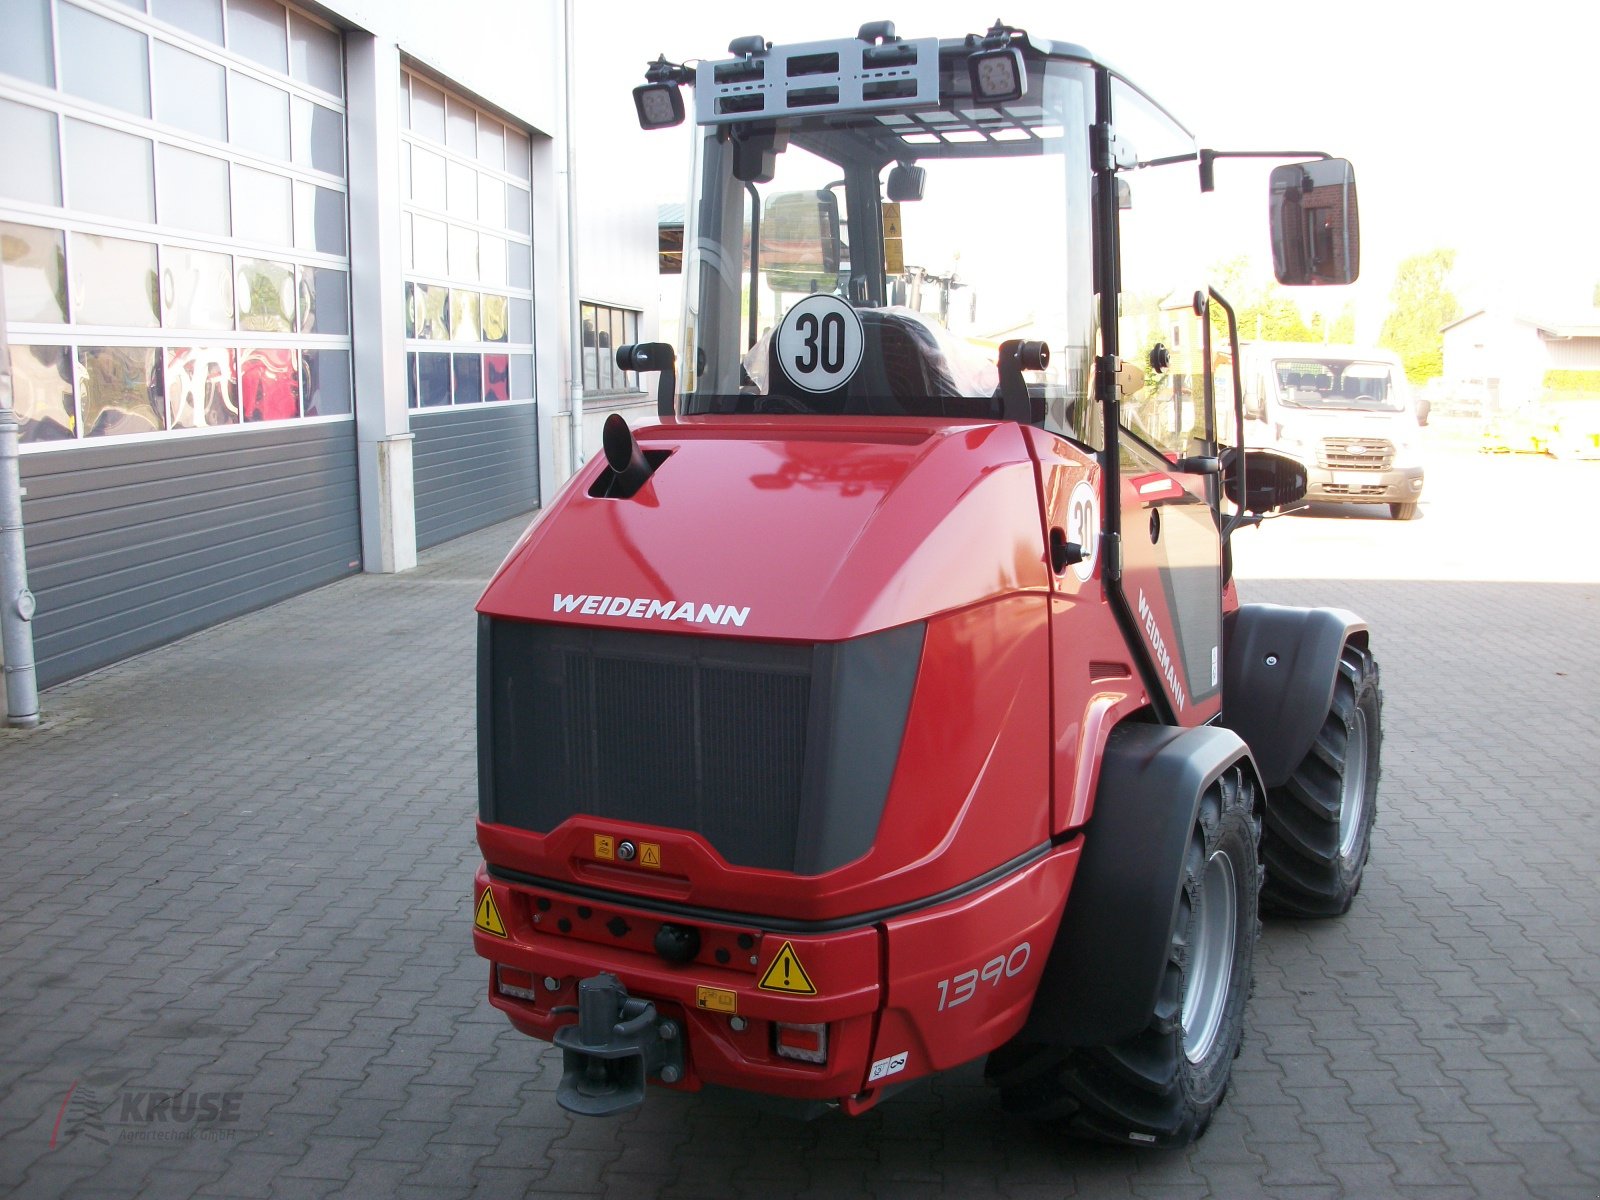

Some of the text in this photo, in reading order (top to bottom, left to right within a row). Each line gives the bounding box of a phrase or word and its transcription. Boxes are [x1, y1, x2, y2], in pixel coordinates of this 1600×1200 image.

[795, 312, 846, 374] 30
[552, 593, 751, 627] WEIDEMANN
[1138, 587, 1185, 713] WEIDEMANN
[936, 941, 1032, 1012] 1390
